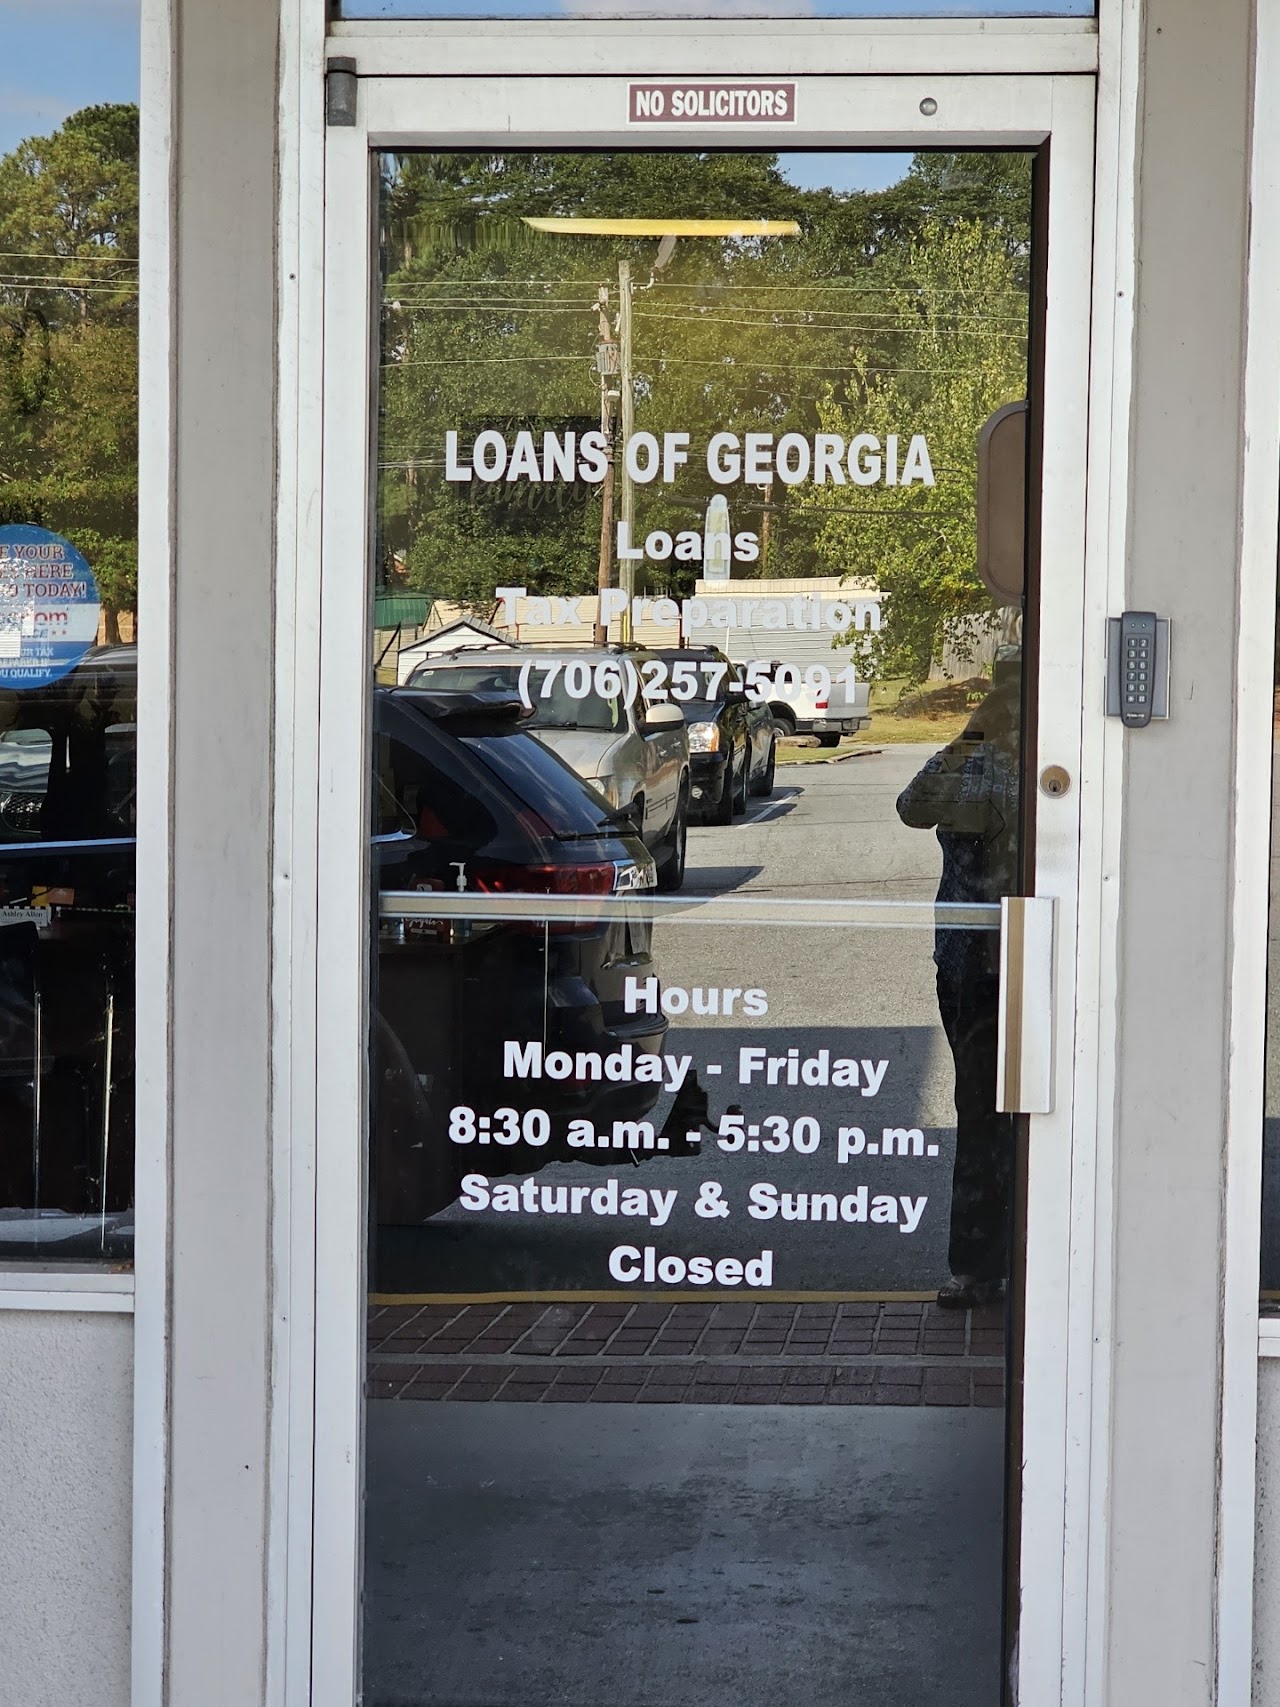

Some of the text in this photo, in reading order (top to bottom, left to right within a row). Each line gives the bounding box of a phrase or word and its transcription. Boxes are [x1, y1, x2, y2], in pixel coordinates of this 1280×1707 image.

[636, 89, 788, 116] NO SOLICITORS
[445, 429, 936, 486] LOANS OF GEORGIA
[14, 544, 64, 560] YOUR
[617, 521, 760, 562] Loans
[23, 583, 86, 598] TODAY!
[495, 587, 881, 637] Tax Preparation
[518, 658, 856, 709] (706)257-5091
[624, 976, 769, 1016] Hours
[503, 1040, 889, 1097] Monday - Friday
[448, 1106, 940, 1163] 8:30 a.m. - 5:30 p.m.
[459, 1173, 928, 1233] Saturday & Sunday
[608, 1244, 773, 1286] Closed
